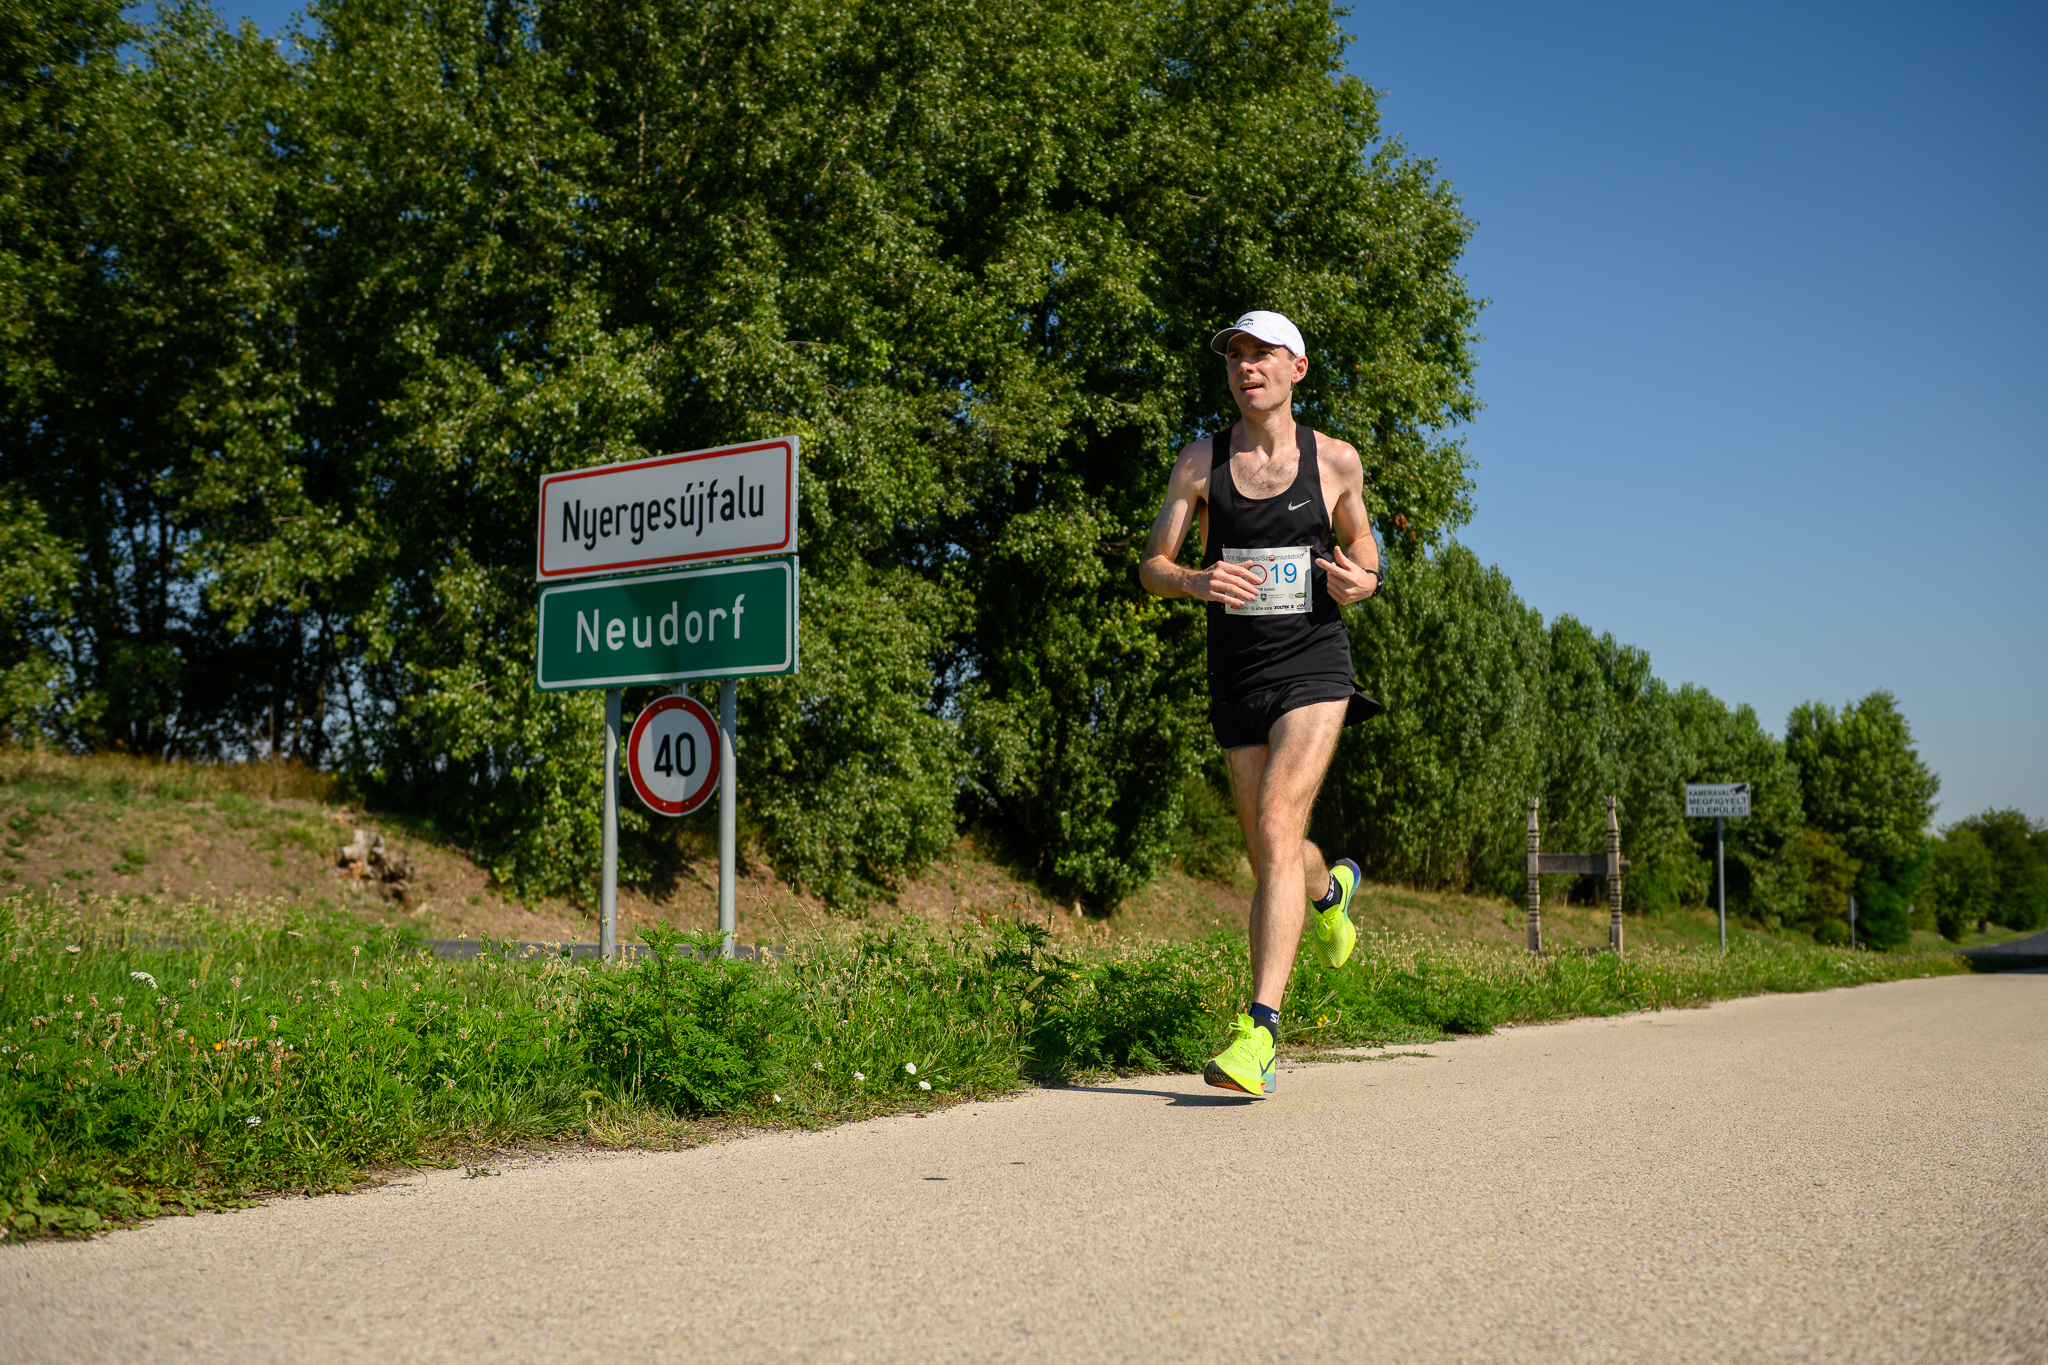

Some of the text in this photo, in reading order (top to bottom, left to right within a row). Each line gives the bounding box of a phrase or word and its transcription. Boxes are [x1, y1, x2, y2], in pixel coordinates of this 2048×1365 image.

[562, 475, 765, 551] Nyergesújfalu
[576, 593, 746, 654] Neudorf
[653, 732, 696, 777] 40
[1688, 788, 1730, 796] KAMERÁVAL
[1688, 797, 1747, 805] MEGFIGYELT
[1690, 805, 1747, 814] TELEPÜLÉS!
